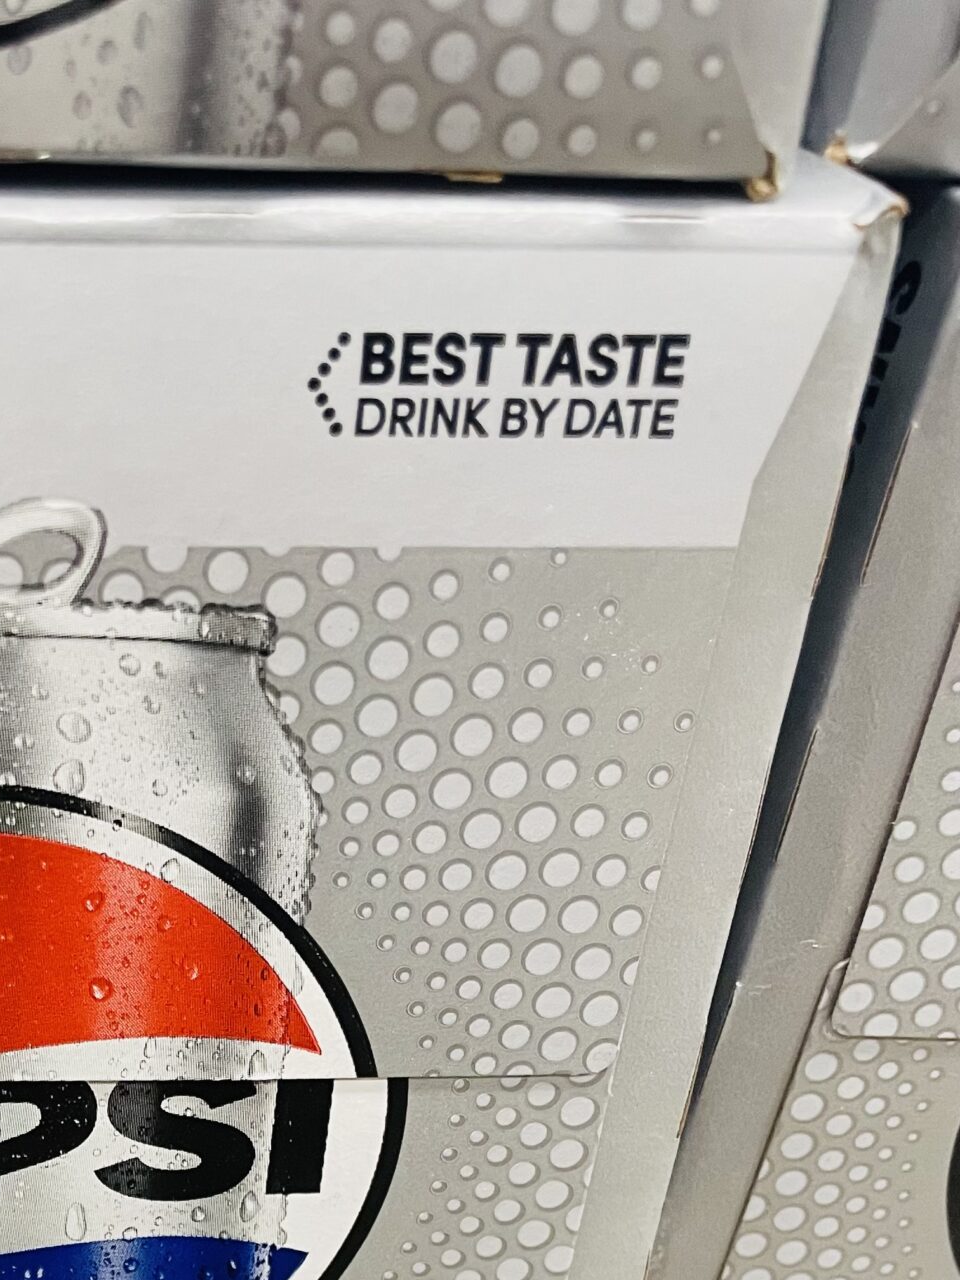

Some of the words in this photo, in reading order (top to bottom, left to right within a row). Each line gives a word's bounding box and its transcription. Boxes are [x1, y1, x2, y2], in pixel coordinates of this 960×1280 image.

[359, 333, 505, 386] BEST
[517, 334, 691, 387] TASTE
[354, 398, 488, 437] DRINK
[499, 399, 561, 438] BY
[564, 398, 679, 439] DATE
